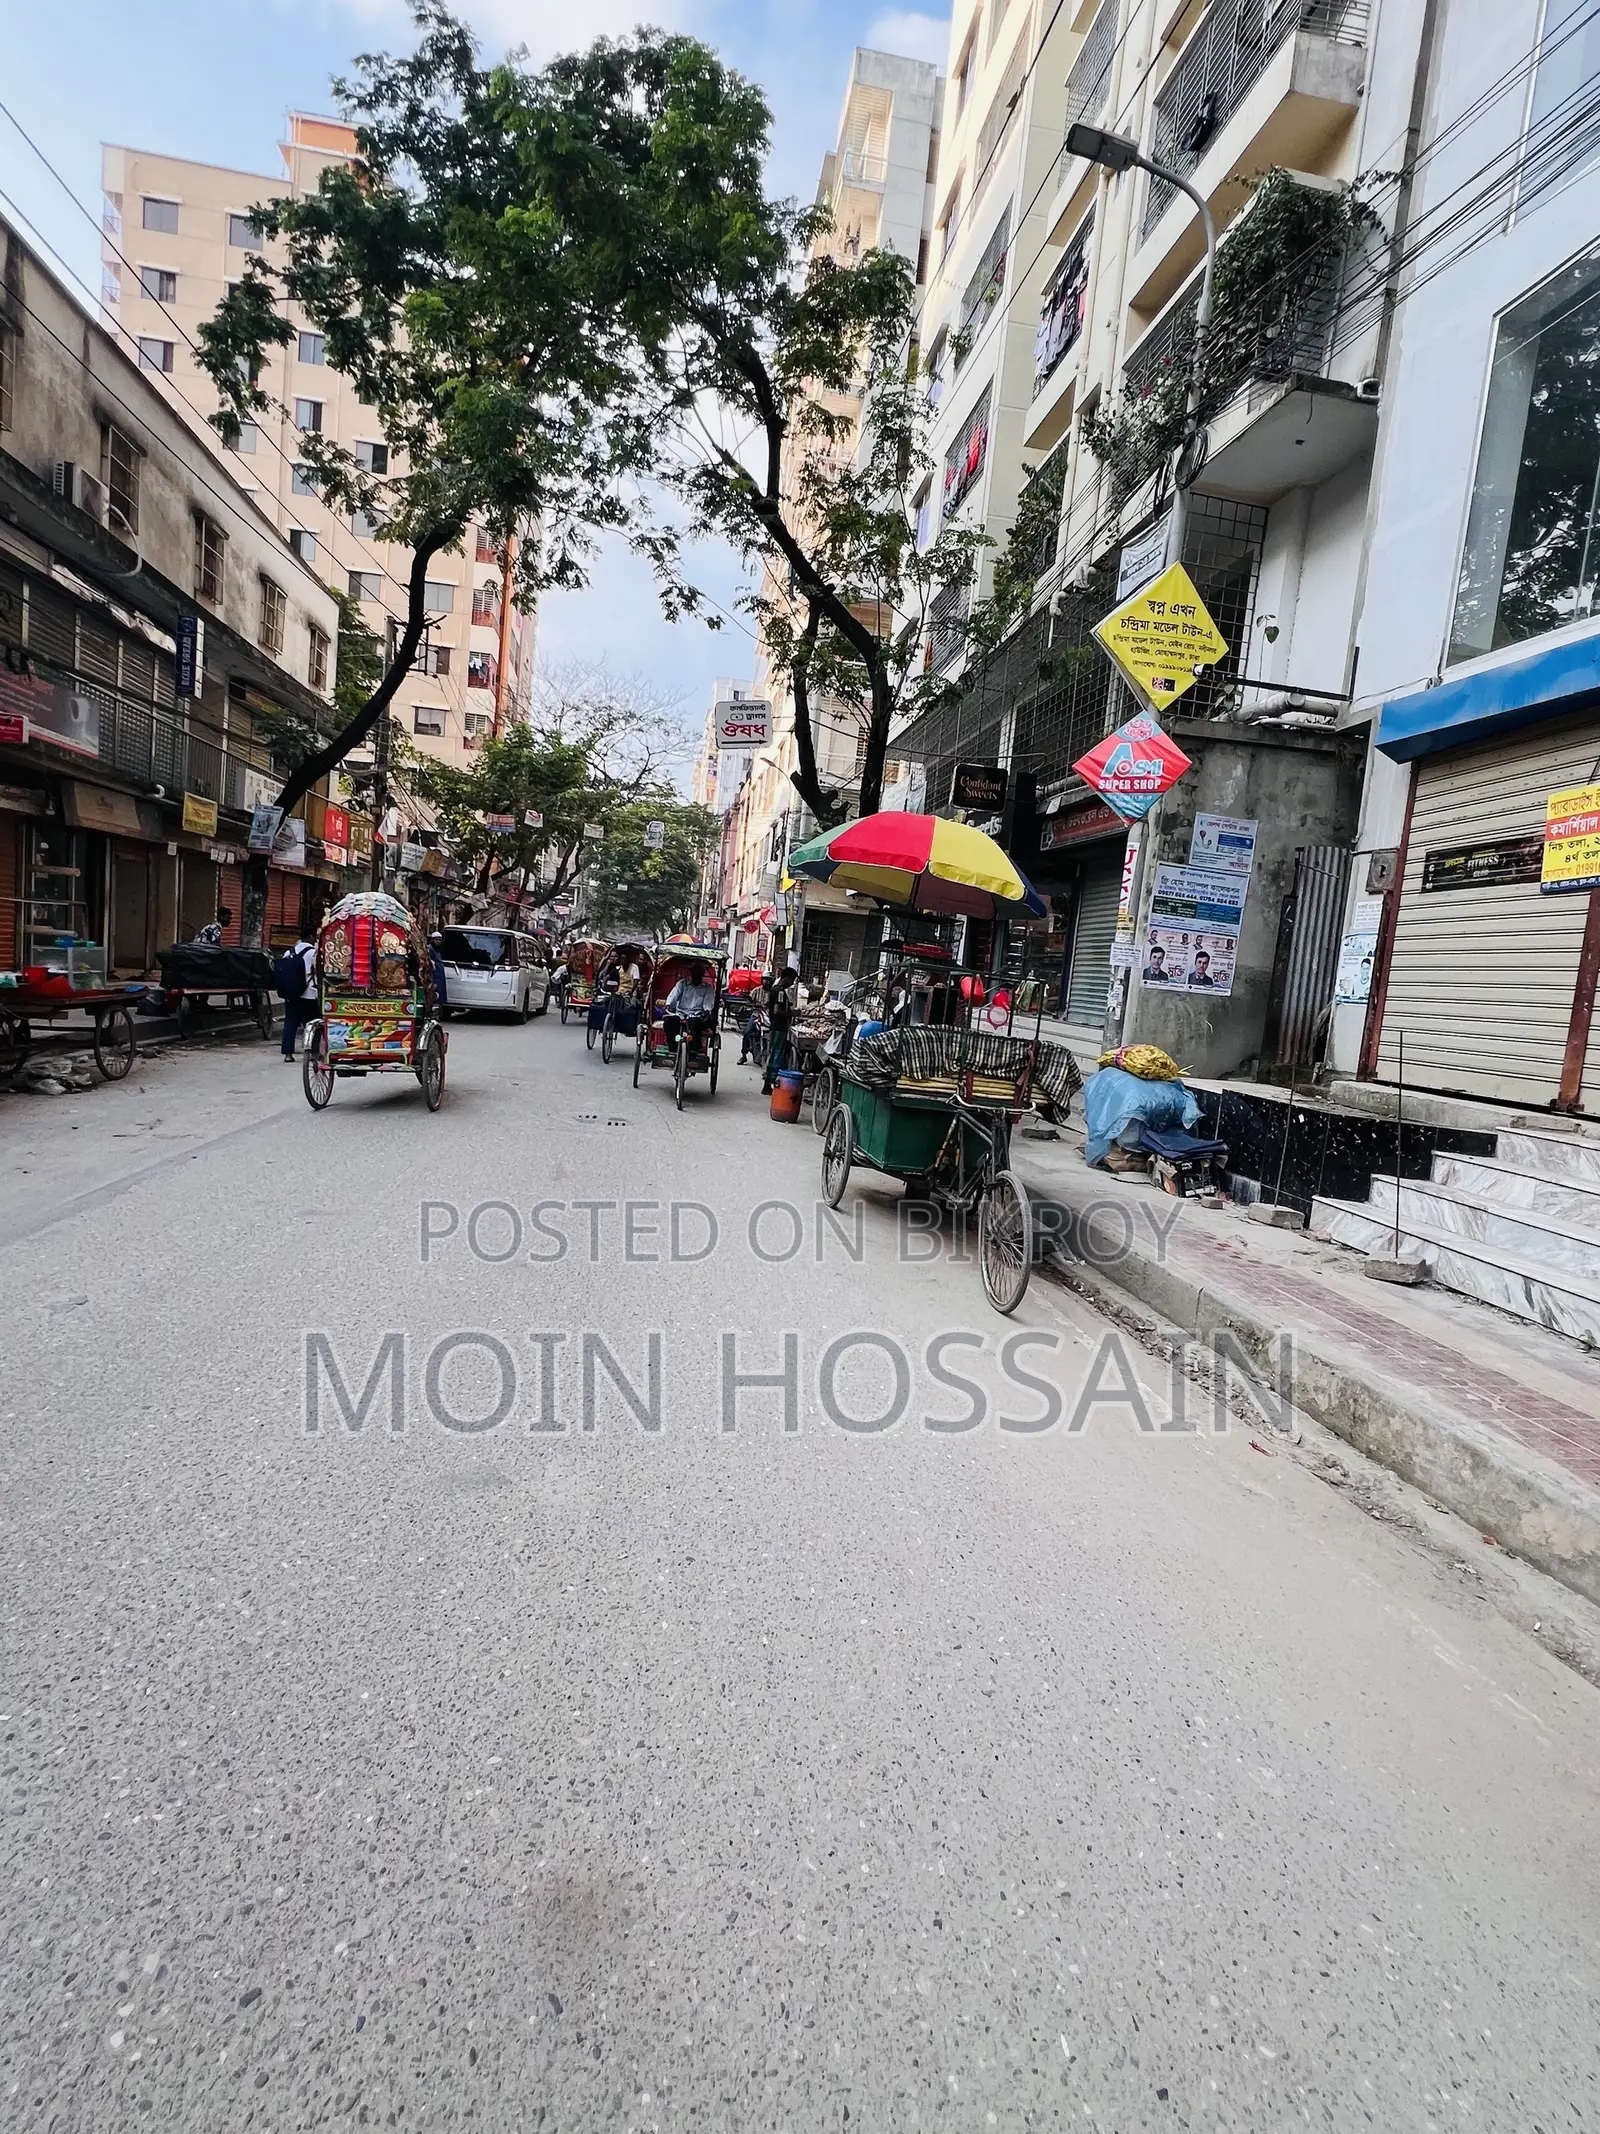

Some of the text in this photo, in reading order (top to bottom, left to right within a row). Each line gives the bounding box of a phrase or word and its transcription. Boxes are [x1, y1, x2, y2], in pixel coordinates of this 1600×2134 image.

[1147, 599, 1197, 619] স্বপ্ন এখন
[1120, 616, 1150, 632] চন্দ্রিমা
[1153, 621, 1180, 635] মডেল
[720, 719, 768, 738] ঔষধ
[963, 786, 998, 800] Sweets
[1098, 779, 1162, 790] SUPER SHOP
[1550, 791, 1594, 816] প্যারাডাইস
[1550, 814, 1600, 837] কমার্শিয়াল
[1548, 841, 1564, 853] নিচ
[1467, 855, 1500, 869] FITNESS
